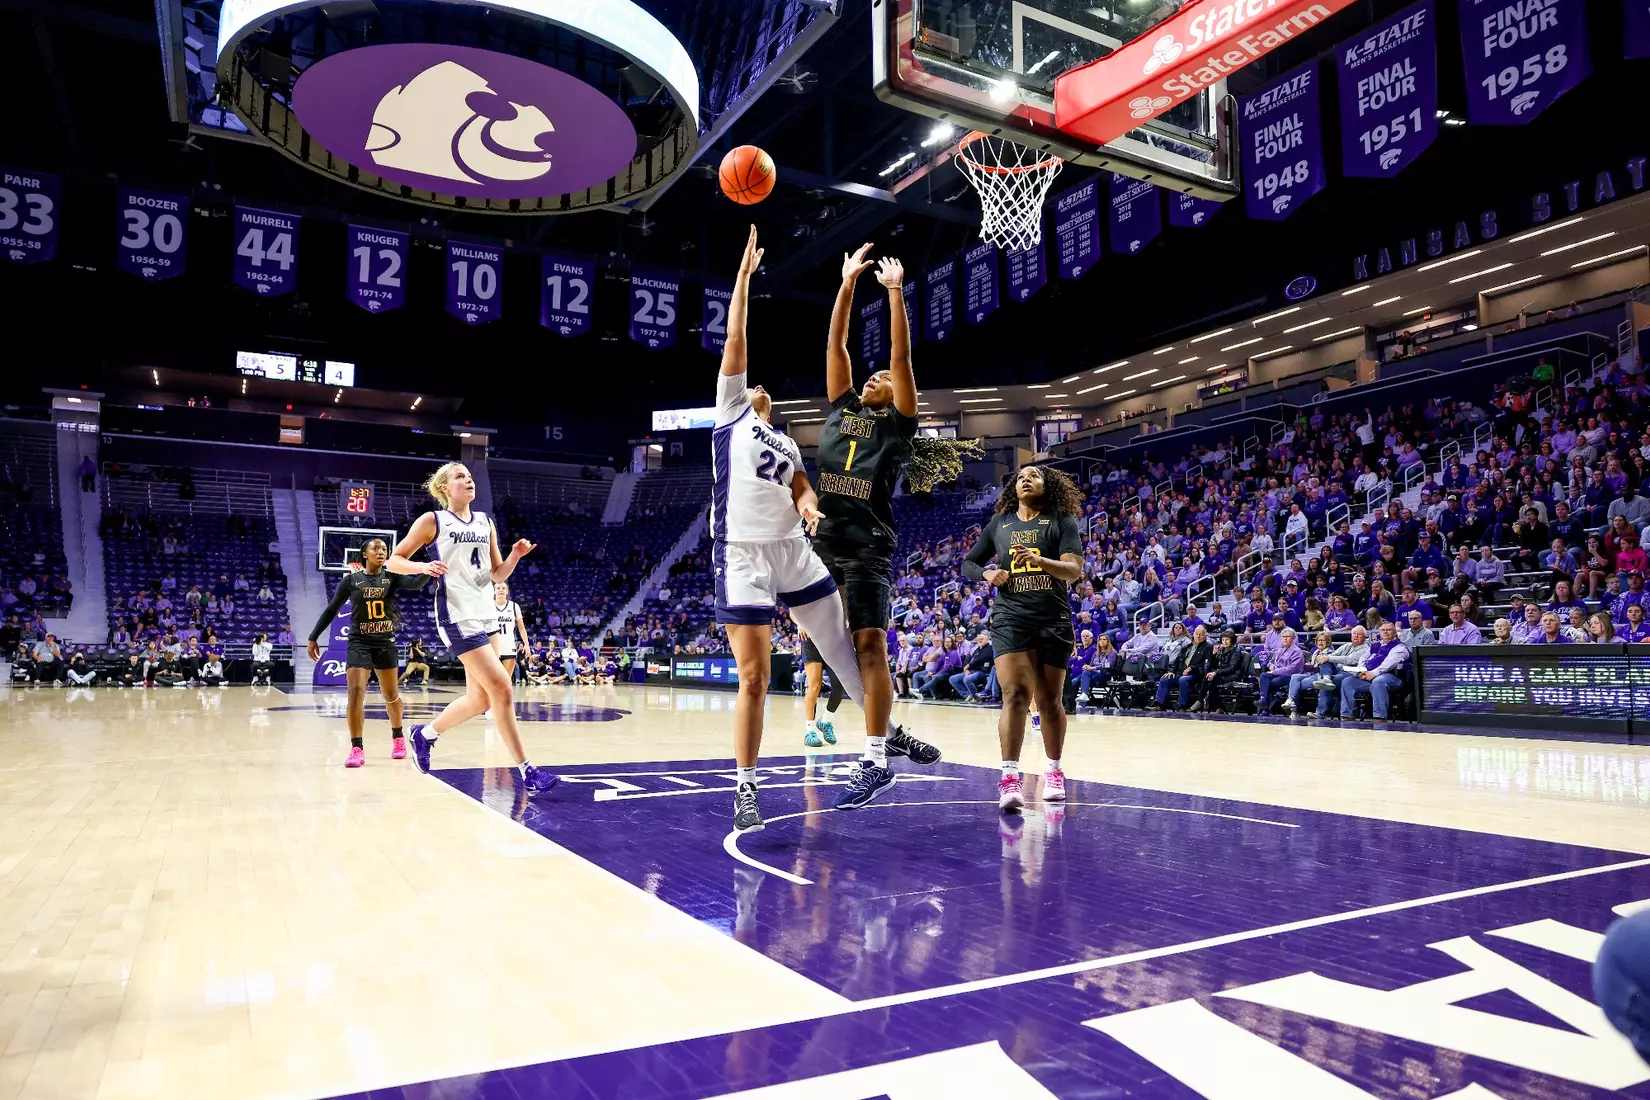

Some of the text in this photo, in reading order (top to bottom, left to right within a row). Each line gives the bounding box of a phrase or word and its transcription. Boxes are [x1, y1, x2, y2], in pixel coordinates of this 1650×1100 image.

[1186, 0, 1275, 52] State
[1345, 9, 1426, 65] K-STATE
[1484, 7, 1558, 58] FOUR
[1350, 29, 1420, 69] MEN'S BASKETBALL
[1358, 57, 1416, 99] FINAL
[1481, 44, 1568, 100] 1958
[1244, 70, 1311, 116] K-STATE
[1249, 88, 1307, 120] MEN'S BASKETBALL
[1358, 75, 1415, 117] FOUR
[1254, 113, 1303, 147] FINAL
[1359, 107, 1422, 154] 1951
[1255, 129, 1303, 164] FOUR
[4, 174, 40, 188] PARR
[1254, 159, 1309, 200] 1948
[129, 195, 178, 211] BOOZER
[1058, 184, 1094, 210] K-STATE
[1112, 190, 1131, 206] SWEET
[1118, 202, 1131, 214] 2018
[1180, 199, 1194, 211] 1961
[0, 187, 53, 235] 33
[242, 214, 293, 229] MURRELL
[1057, 208, 1095, 233] SWEET SIXTEEN
[1118, 211, 1131, 222] 2023
[121, 209, 183, 253] 30
[357, 232, 399, 246] KRUGER
[237, 228, 294, 270] 44
[452, 247, 499, 261] WILLIAMS
[966, 242, 993, 261] K-STATE
[1353, 210, 1498, 281] KANSAS
[131, 255, 171, 266] 1956-59
[354, 246, 401, 287] 12
[553, 263, 583, 275] EVANS
[928, 261, 953, 281] K-STATE
[971, 262, 987, 275] NCAA
[246, 272, 283, 283] 1962-64
[452, 261, 496, 300] 10
[632, 277, 679, 291] BLACKMAN
[359, 289, 392, 299] 1971-74
[547, 275, 588, 314] 12
[457, 302, 488, 312] 1972-76
[634, 289, 675, 326] 25
[276, 364, 284, 374] 5
[335, 371, 342, 380] 4
[544, 426, 563, 440] 15
[840, 415, 875, 439] WEST
[845, 440, 856, 471] 1
[351, 488, 370, 497] 6:37
[820, 472, 872, 500] VIRGINIA
[347, 497, 366, 512] 20
[1011, 529, 1039, 544] WEST
[470, 547, 481, 569] 4
[1009, 547, 1042, 574] 22
[366, 600, 385, 620] 10
[1455, 666, 1505, 683] HAVE
[1509, 667, 1525, 684] A
[1528, 667, 1589, 684] GAME
[1454, 686, 1527, 704] BEFORE
[1530, 687, 1573, 705] YOU
